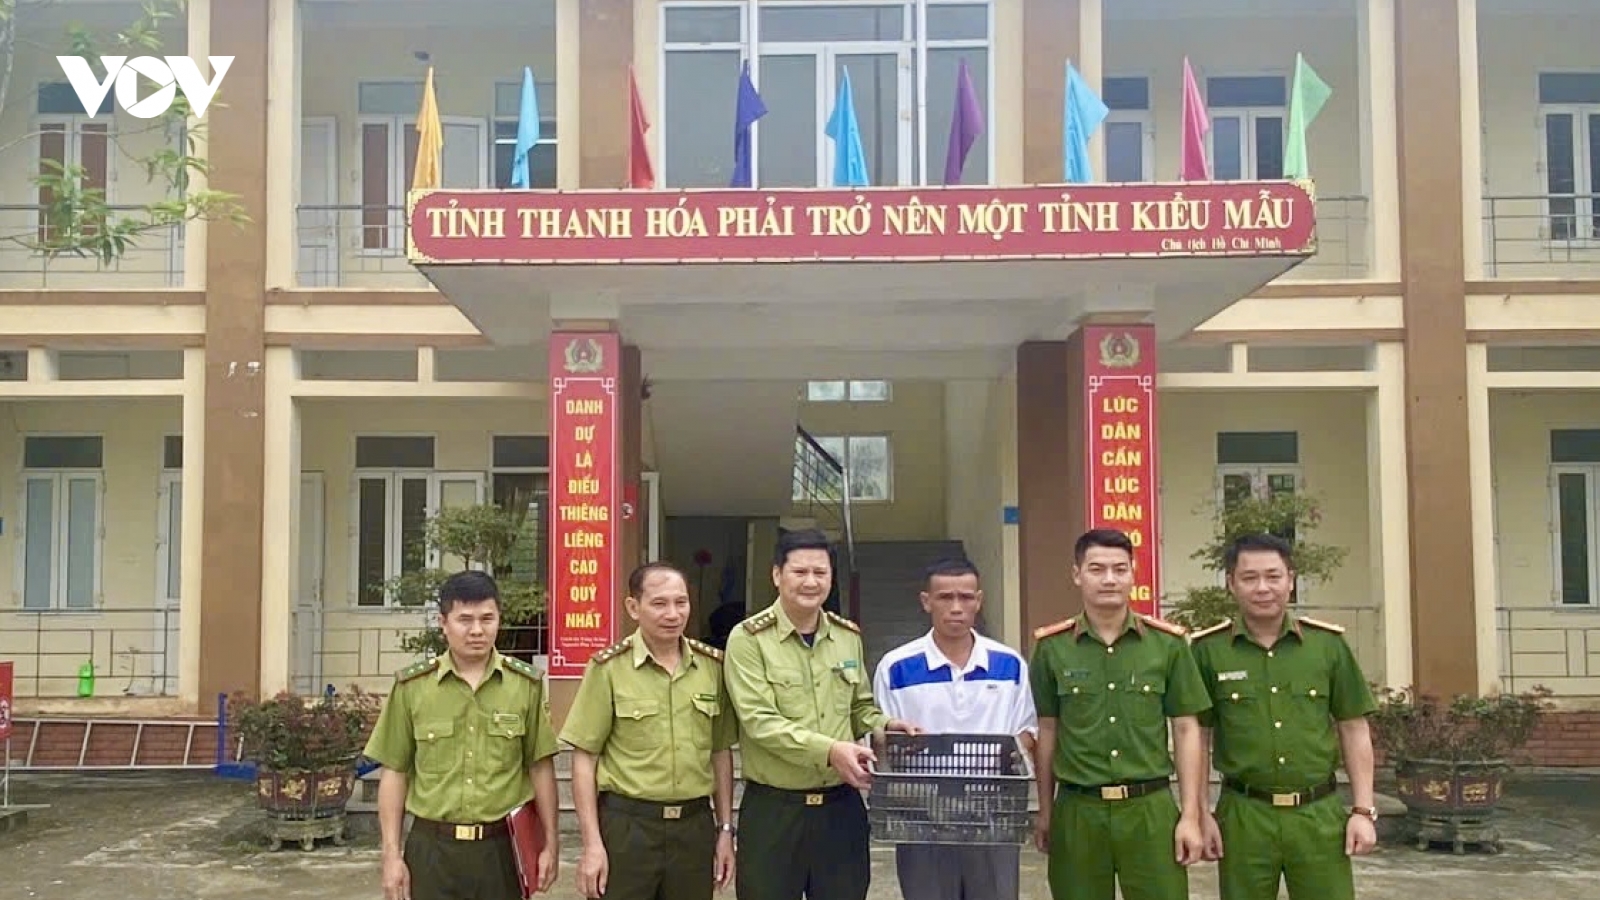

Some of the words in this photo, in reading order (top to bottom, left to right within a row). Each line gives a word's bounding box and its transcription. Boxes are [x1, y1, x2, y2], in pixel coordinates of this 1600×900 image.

[427, 199, 505, 238] TỈNH
[518, 209, 631, 238] THANH
[645, 198, 708, 236] HÓA
[717, 197, 794, 236] PHẢI
[807, 195, 871, 235] TRỞ
[883, 196, 947, 234] NÊN
[958, 197, 1027, 239] MỘT
[1039, 194, 1118, 232] TỈNH
[1131, 192, 1209, 230] KIỂU
[1224, 190, 1293, 229] MẪU
[566, 400, 603, 414] DANH
[1103, 396, 1138, 412] LÚC
[575, 426, 595, 443] DỰ
[1102, 422, 1140, 439] DÂN
[576, 451, 592, 467] LÀ
[1105, 476, 1139, 493] LÚC
[560, 503, 607, 521] THIÊNG
[1104, 502, 1141, 520] DÂN
[565, 530, 603, 547] LIÊNG
[570, 560, 597, 574] CAO
[571, 584, 596, 602] QUÝ
[566, 609, 601, 627] NHẤT
